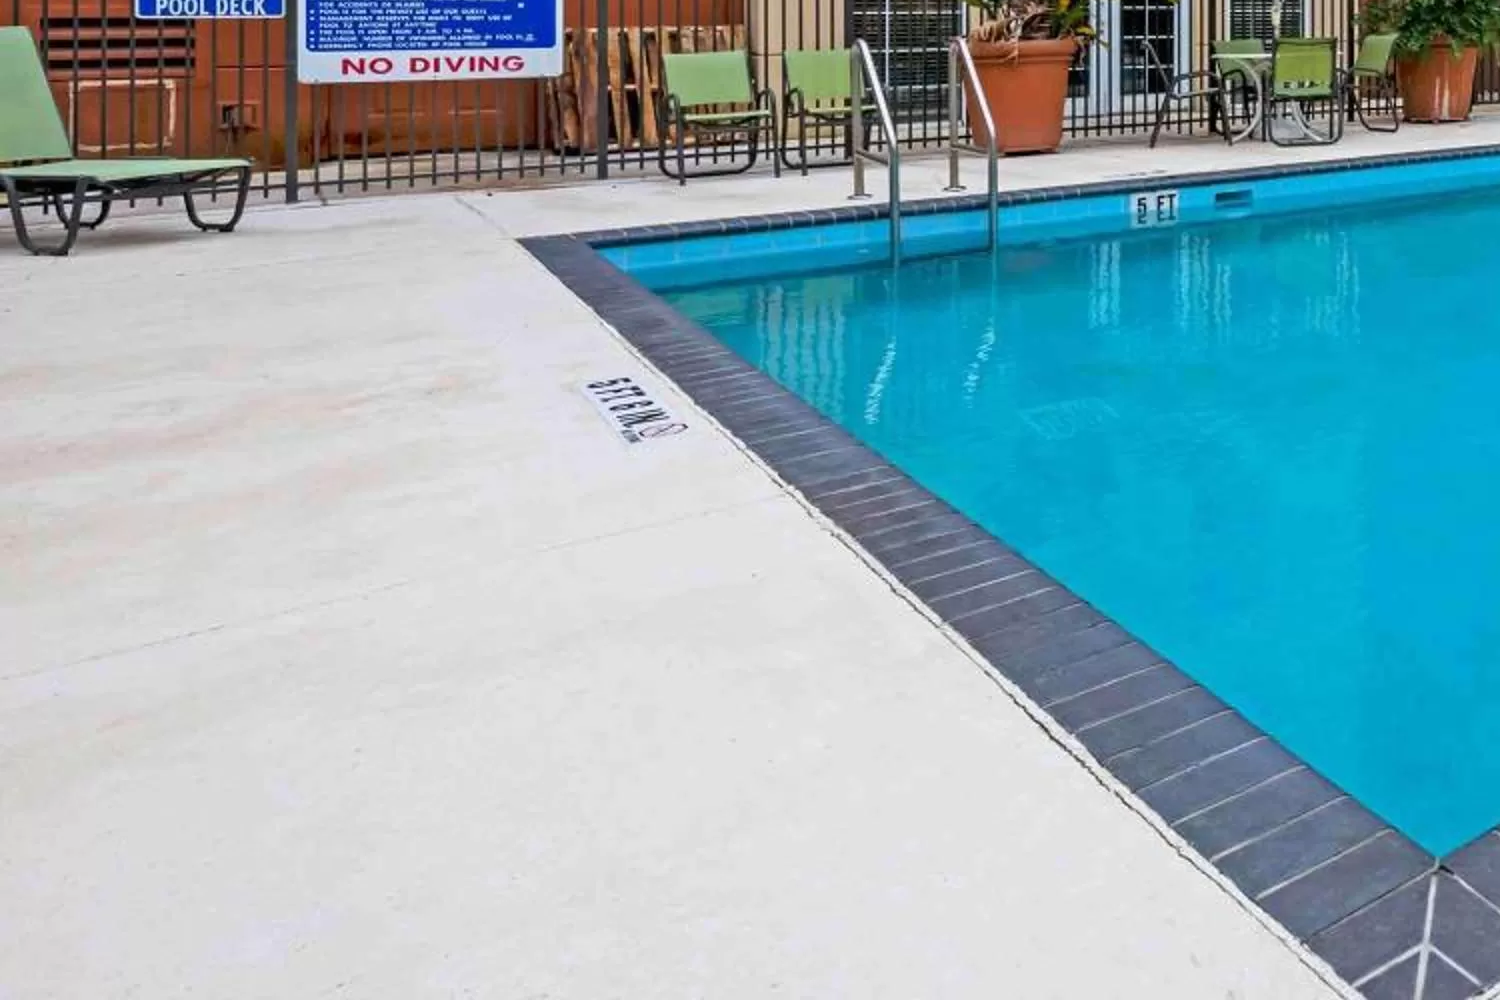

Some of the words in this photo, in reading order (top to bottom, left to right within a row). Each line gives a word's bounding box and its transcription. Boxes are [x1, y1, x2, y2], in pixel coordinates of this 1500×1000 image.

[341, 57, 393, 75] NO
[409, 56, 525, 73] DIVING
[1157, 193, 1177, 218] FT
